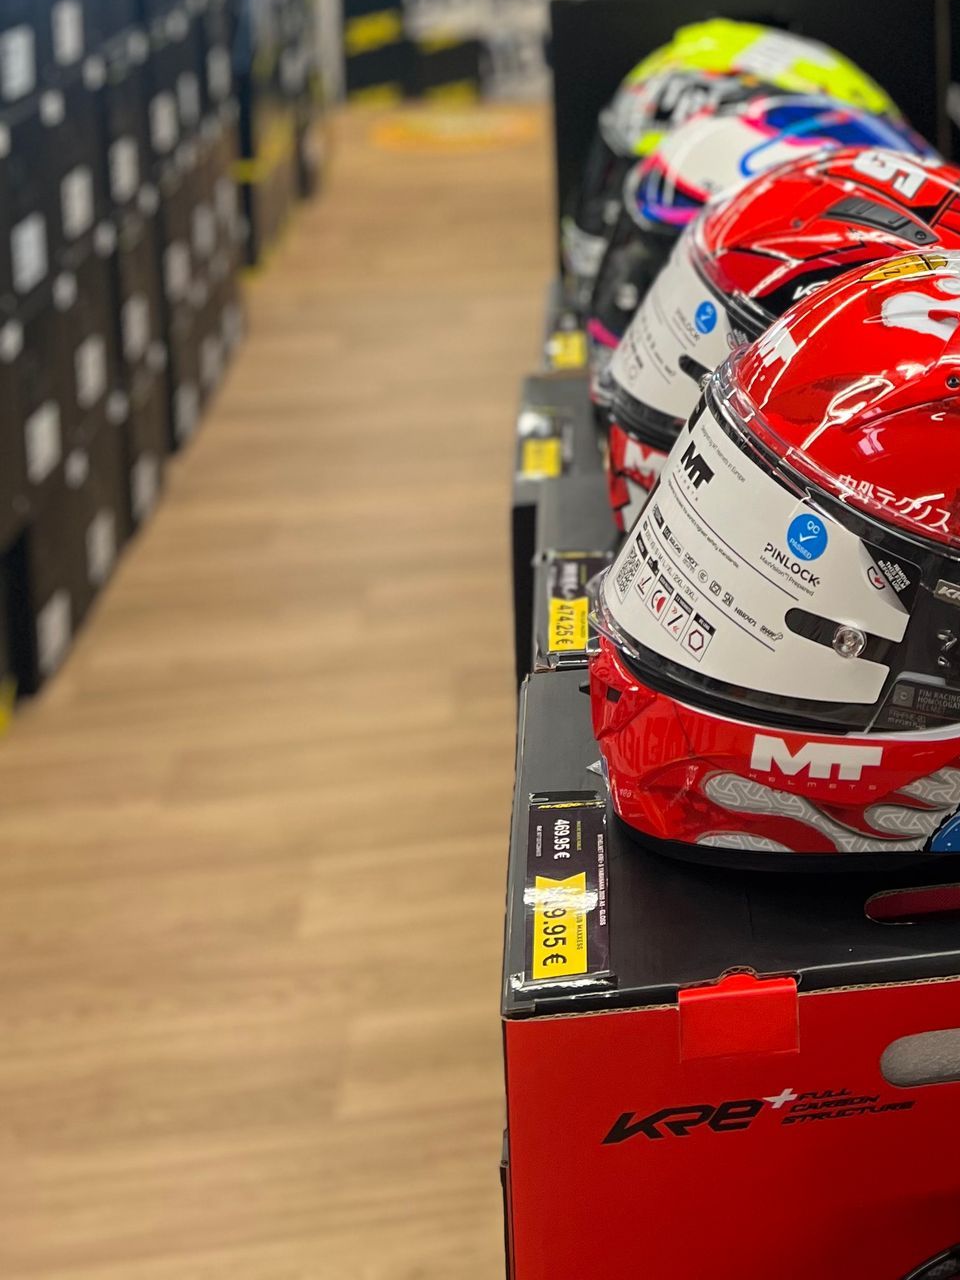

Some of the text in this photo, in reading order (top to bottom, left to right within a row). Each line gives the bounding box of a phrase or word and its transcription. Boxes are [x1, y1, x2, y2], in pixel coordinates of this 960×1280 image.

[624, 437, 669, 479] M
[681, 440, 715, 490] MT
[790, 538, 812, 560] PASSED
[875, 560, 896, 582] BEFORE
[891, 563, 913, 586] REMOVE
[789, 575, 815, 597] Prepared
[555, 604, 574, 646] 474.25 €
[919, 689, 933, 699] FIM
[750, 734, 883, 780] MT
[749, 773, 877, 790] HELMETS
[554, 819, 570, 850] 469.95
[542, 953, 567, 967] €
[789, 1095, 881, 1114] CARBON
[797, 1087, 852, 1101] FULL
[781, 1100, 916, 1126] STRUCTURE
